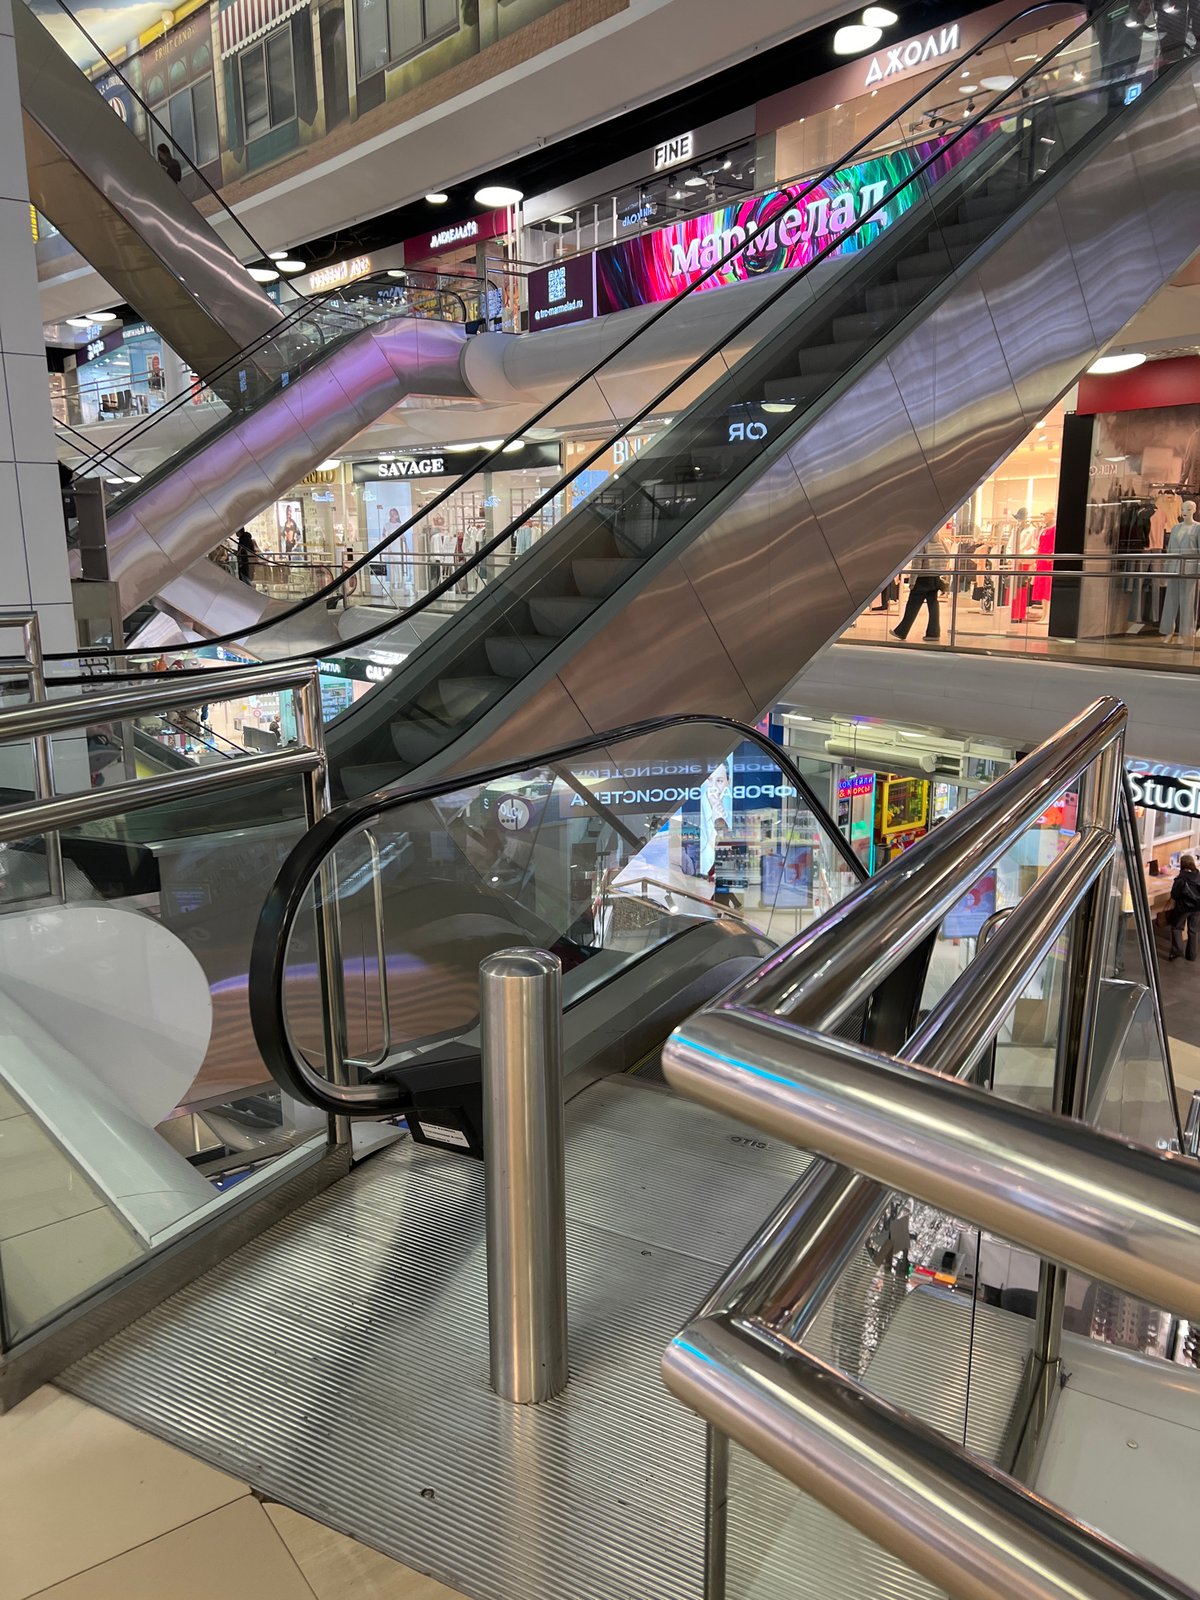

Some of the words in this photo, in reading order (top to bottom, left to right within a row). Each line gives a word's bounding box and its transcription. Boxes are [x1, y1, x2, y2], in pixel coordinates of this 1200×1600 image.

[865, 23, 960, 87] ДЖОЛИ
[654, 135, 690, 167] FINE
[378, 458, 444, 477] SAVAGE
[839, 776, 873, 788] КОКЕЙЛИ
[730, 1136, 767, 1149] OTIS
